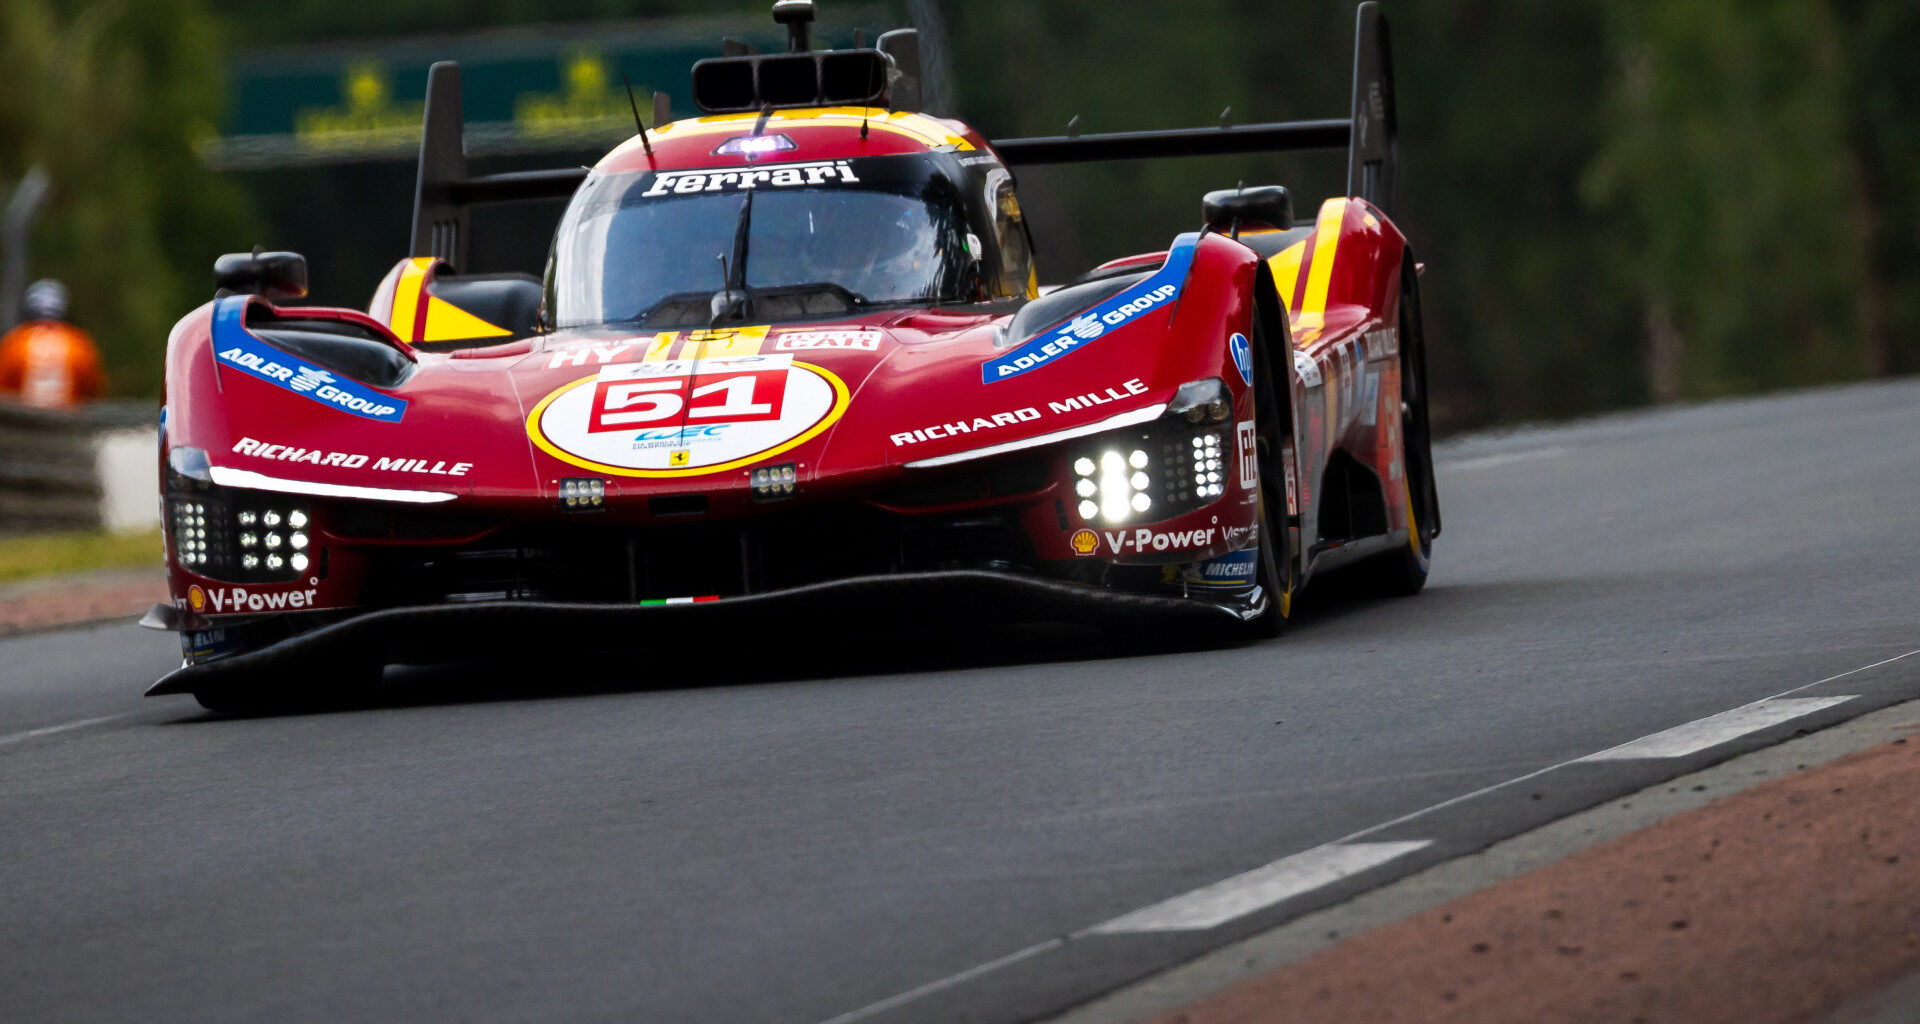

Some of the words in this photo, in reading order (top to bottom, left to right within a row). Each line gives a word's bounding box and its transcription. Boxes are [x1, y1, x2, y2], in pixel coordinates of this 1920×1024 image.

[642, 159, 860, 198] Ferrari
[998, 335, 1079, 377] ADLER
[1102, 284, 1177, 325] GROUP
[218, 347, 293, 382] ADLER
[315, 385, 396, 416] GROUP
[600, 376, 772, 425] 51
[635, 424, 731, 440] WEC
[890, 407, 1042, 446] RICHARD
[1048, 378, 1149, 415] MILLE
[232, 436, 370, 469] RICHARD
[372, 456, 473, 476] MILLE
[1105, 527, 1215, 554] V-Power
[208, 588, 317, 612] V-Power
